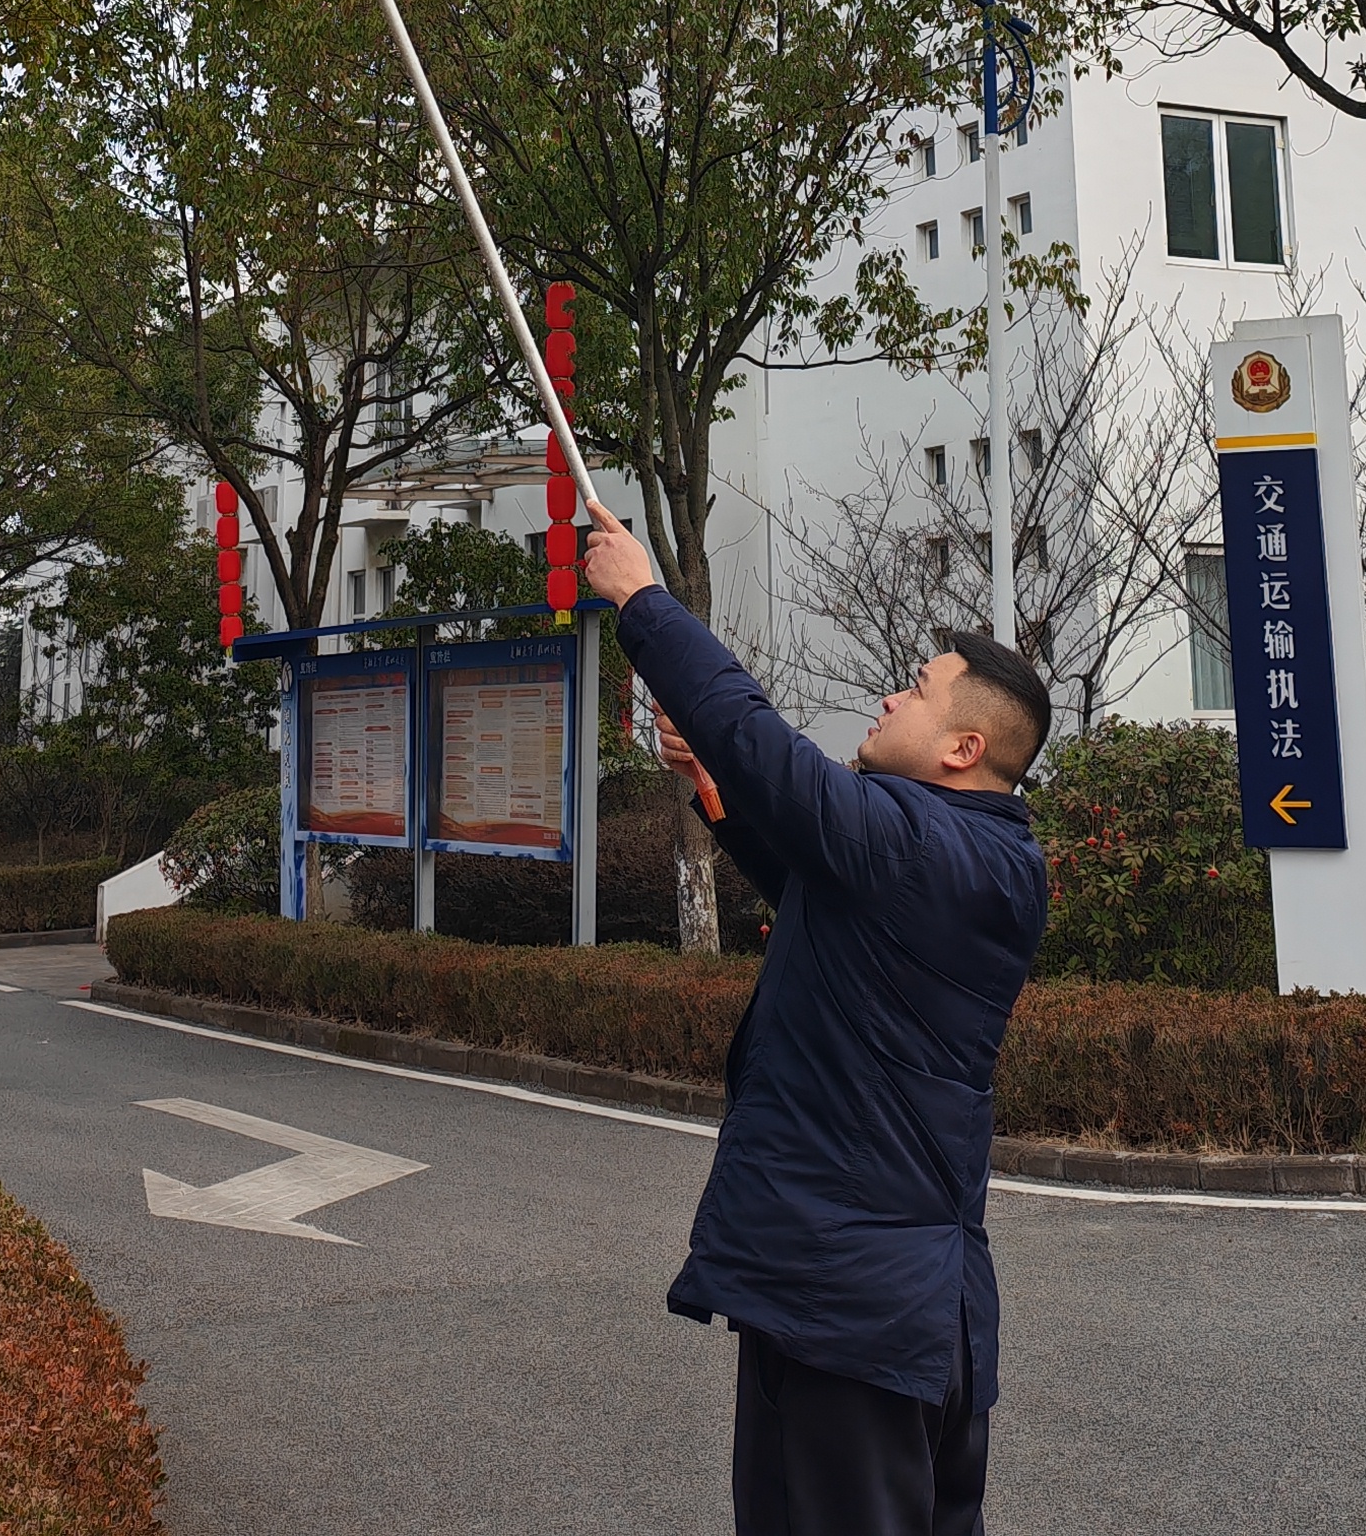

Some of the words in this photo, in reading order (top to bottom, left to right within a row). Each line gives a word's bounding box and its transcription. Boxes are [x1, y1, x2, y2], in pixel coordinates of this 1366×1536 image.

[1254, 475, 1303, 759] 交通运输执法
